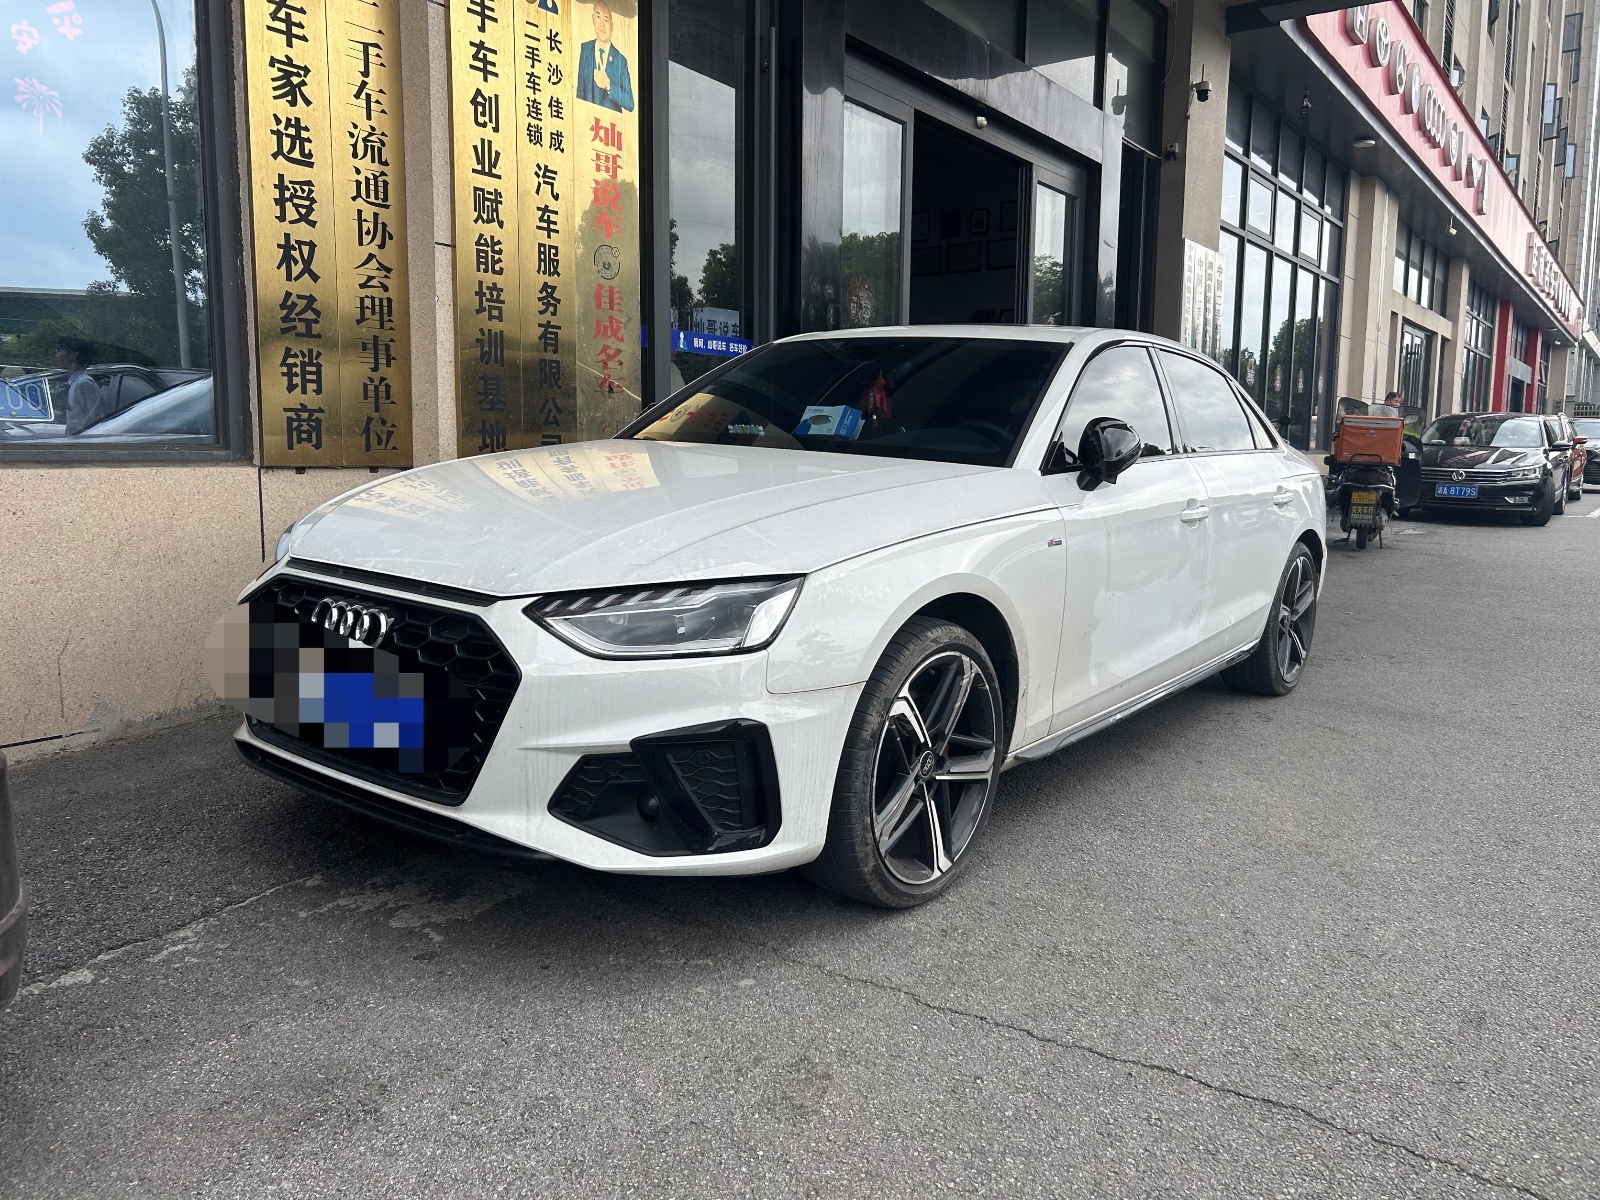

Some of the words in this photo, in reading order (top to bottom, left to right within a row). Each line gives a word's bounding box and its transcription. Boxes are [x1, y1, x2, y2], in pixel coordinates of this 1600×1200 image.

[524, 20, 544, 148] 二手车连锁
[545, 28, 565, 154] 长沙佳成
[589, 116, 624, 240] 灿哥说车
